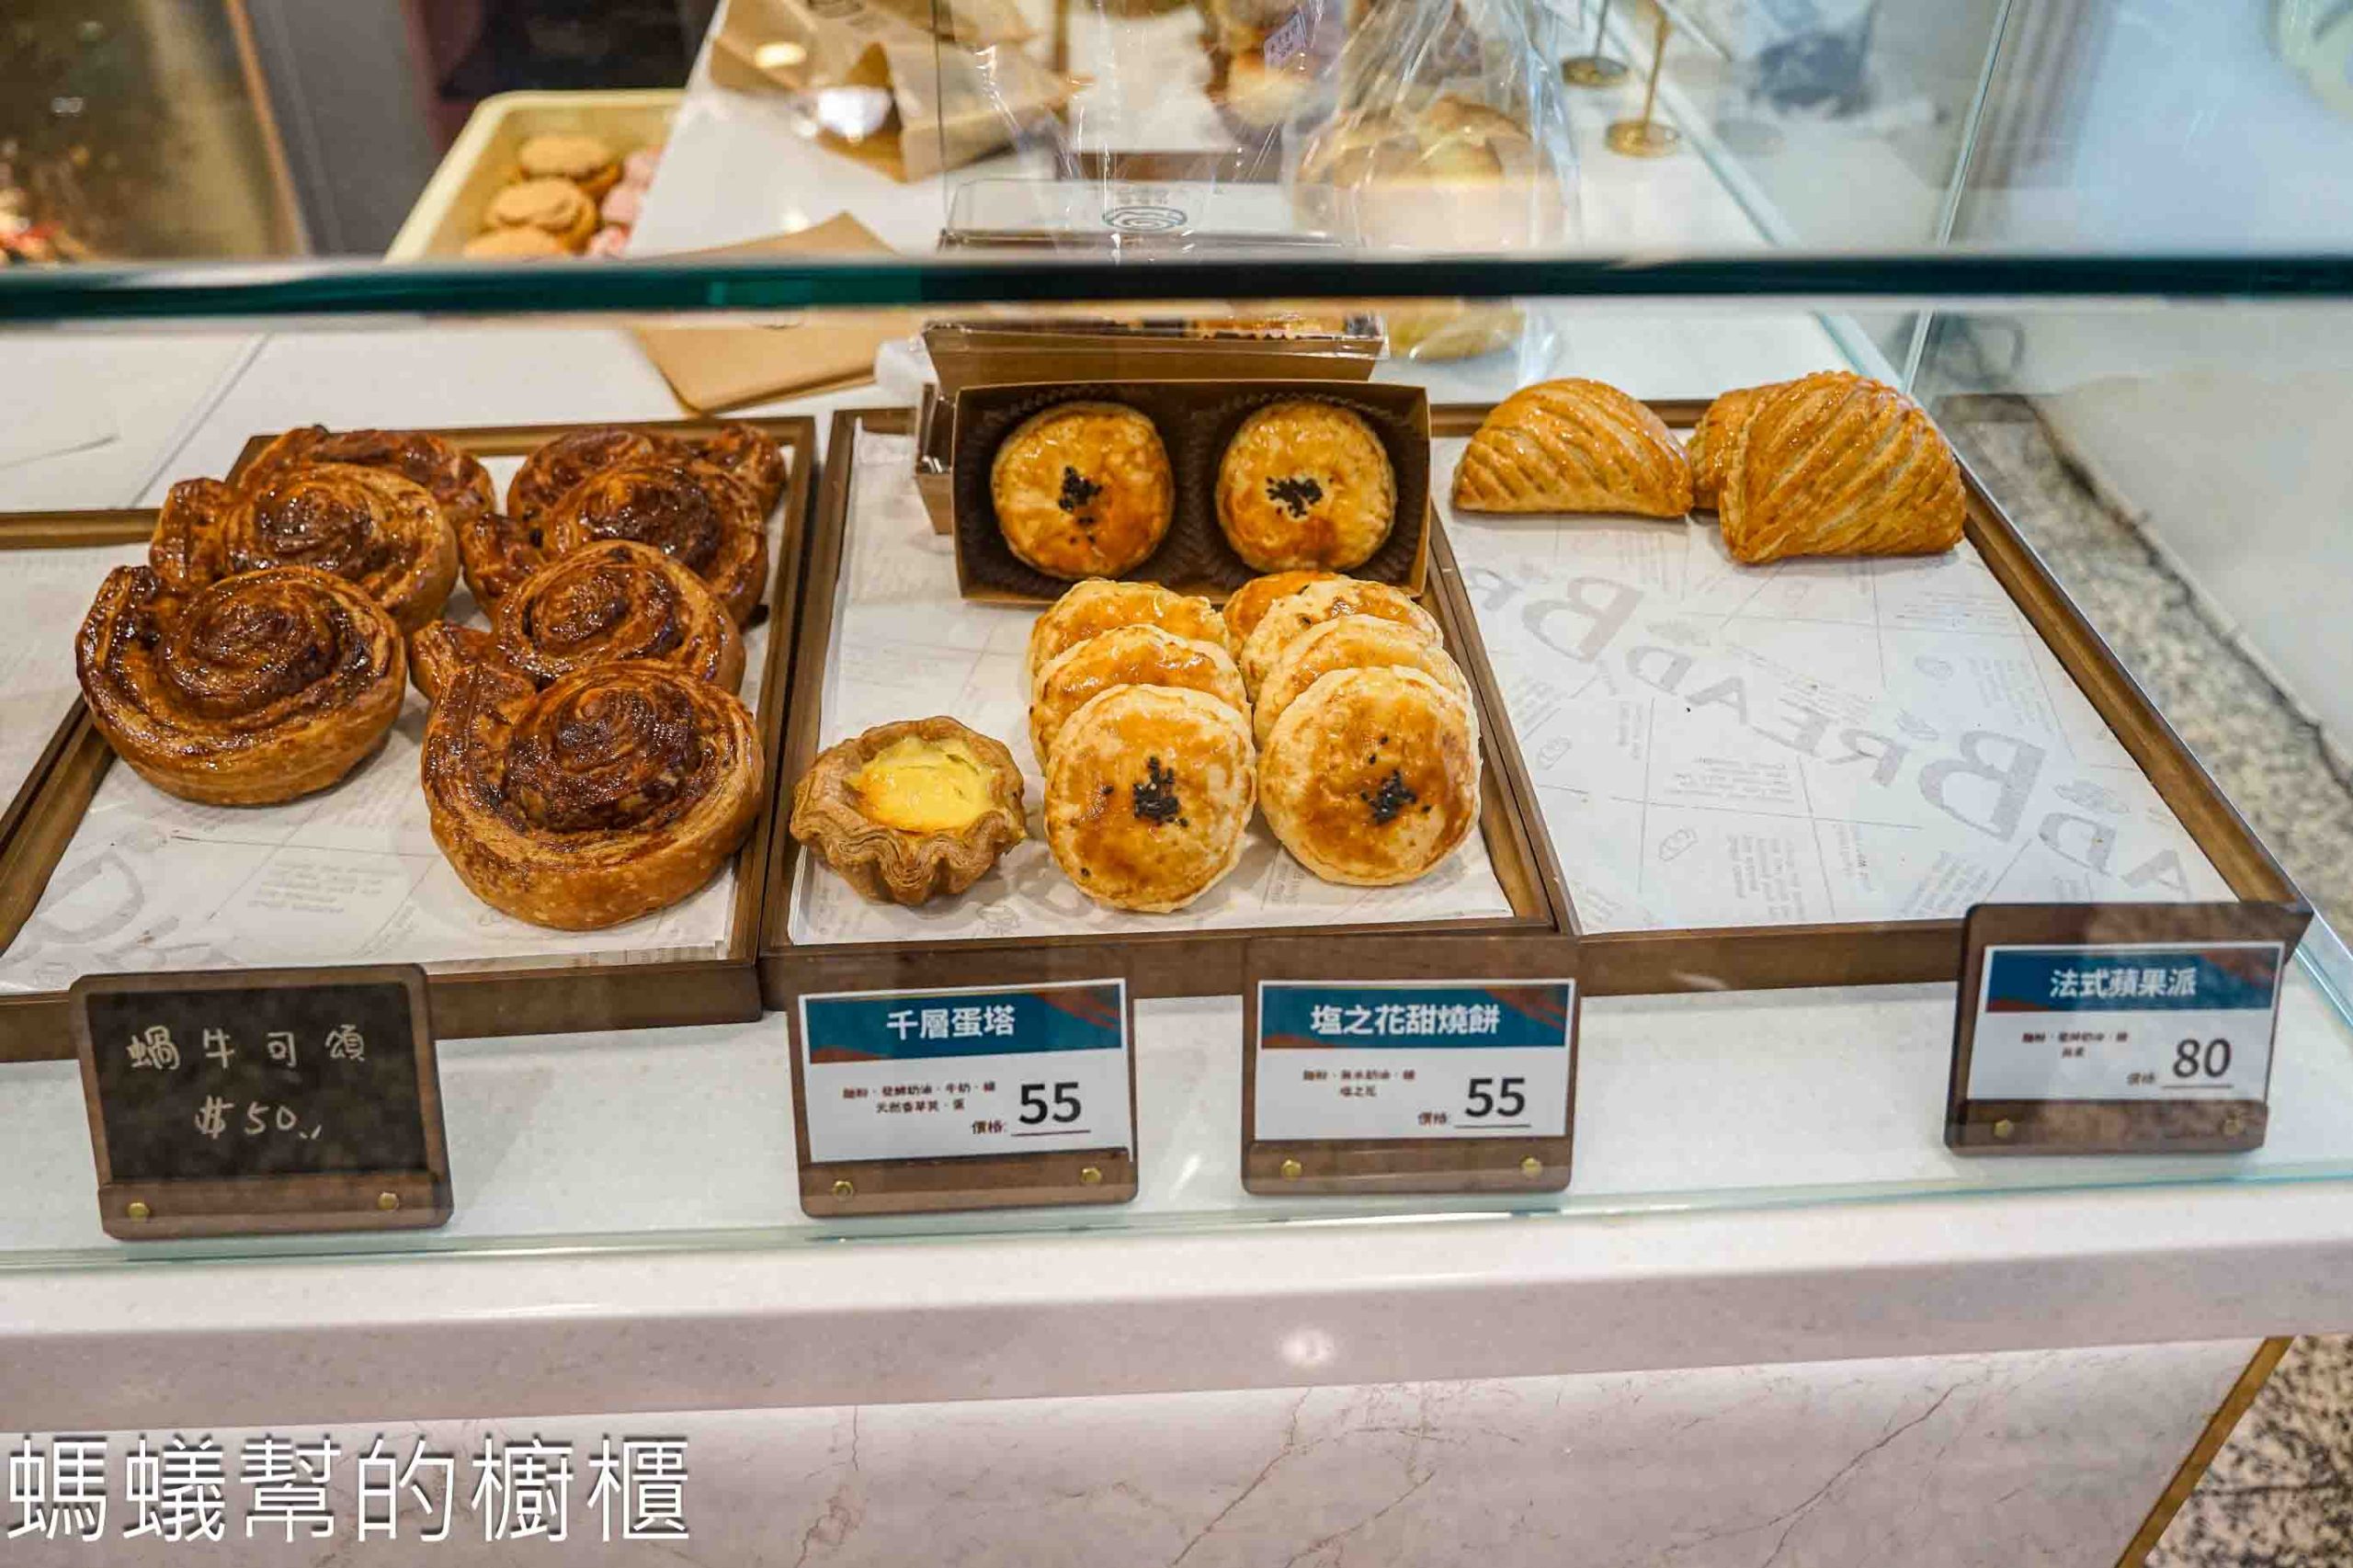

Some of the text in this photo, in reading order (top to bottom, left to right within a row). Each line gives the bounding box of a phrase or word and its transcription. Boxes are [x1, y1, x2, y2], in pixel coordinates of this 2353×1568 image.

[2050, 966, 2198, 998] 法式蘋果派
[886, 1005, 1016, 1040] 千層蛋塔
[1310, 1004, 1500, 1036] 塩之花甜燒餅
[2172, 1038, 2232, 1078] 80
[1018, 1081, 1083, 1126] 55
[1464, 1077, 1526, 1119] 55
